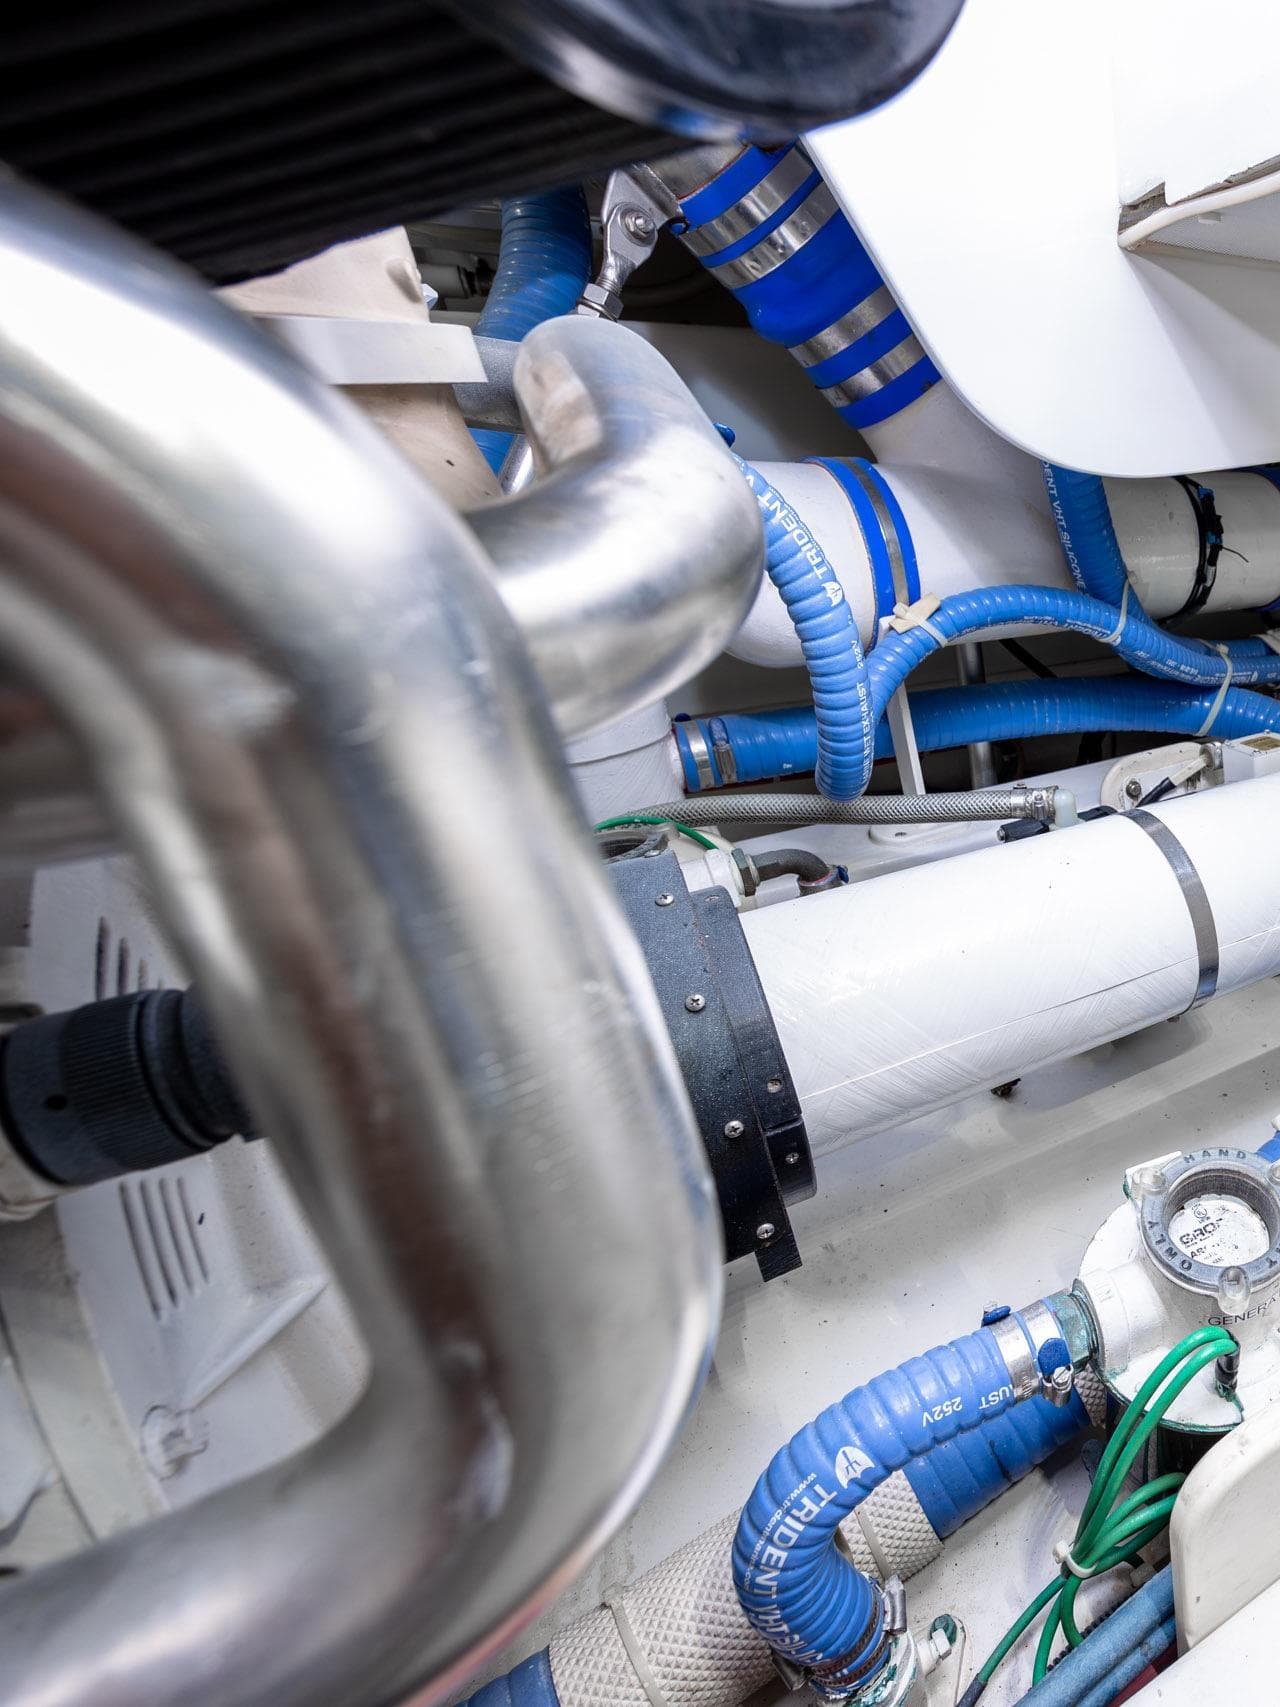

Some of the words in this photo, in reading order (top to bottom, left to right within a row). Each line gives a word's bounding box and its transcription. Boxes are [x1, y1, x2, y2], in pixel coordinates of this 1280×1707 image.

[758, 491, 828, 579] TRIDENT
[922, 1396, 963, 1428] 252V
[754, 1484, 838, 1600] TRIDENT
